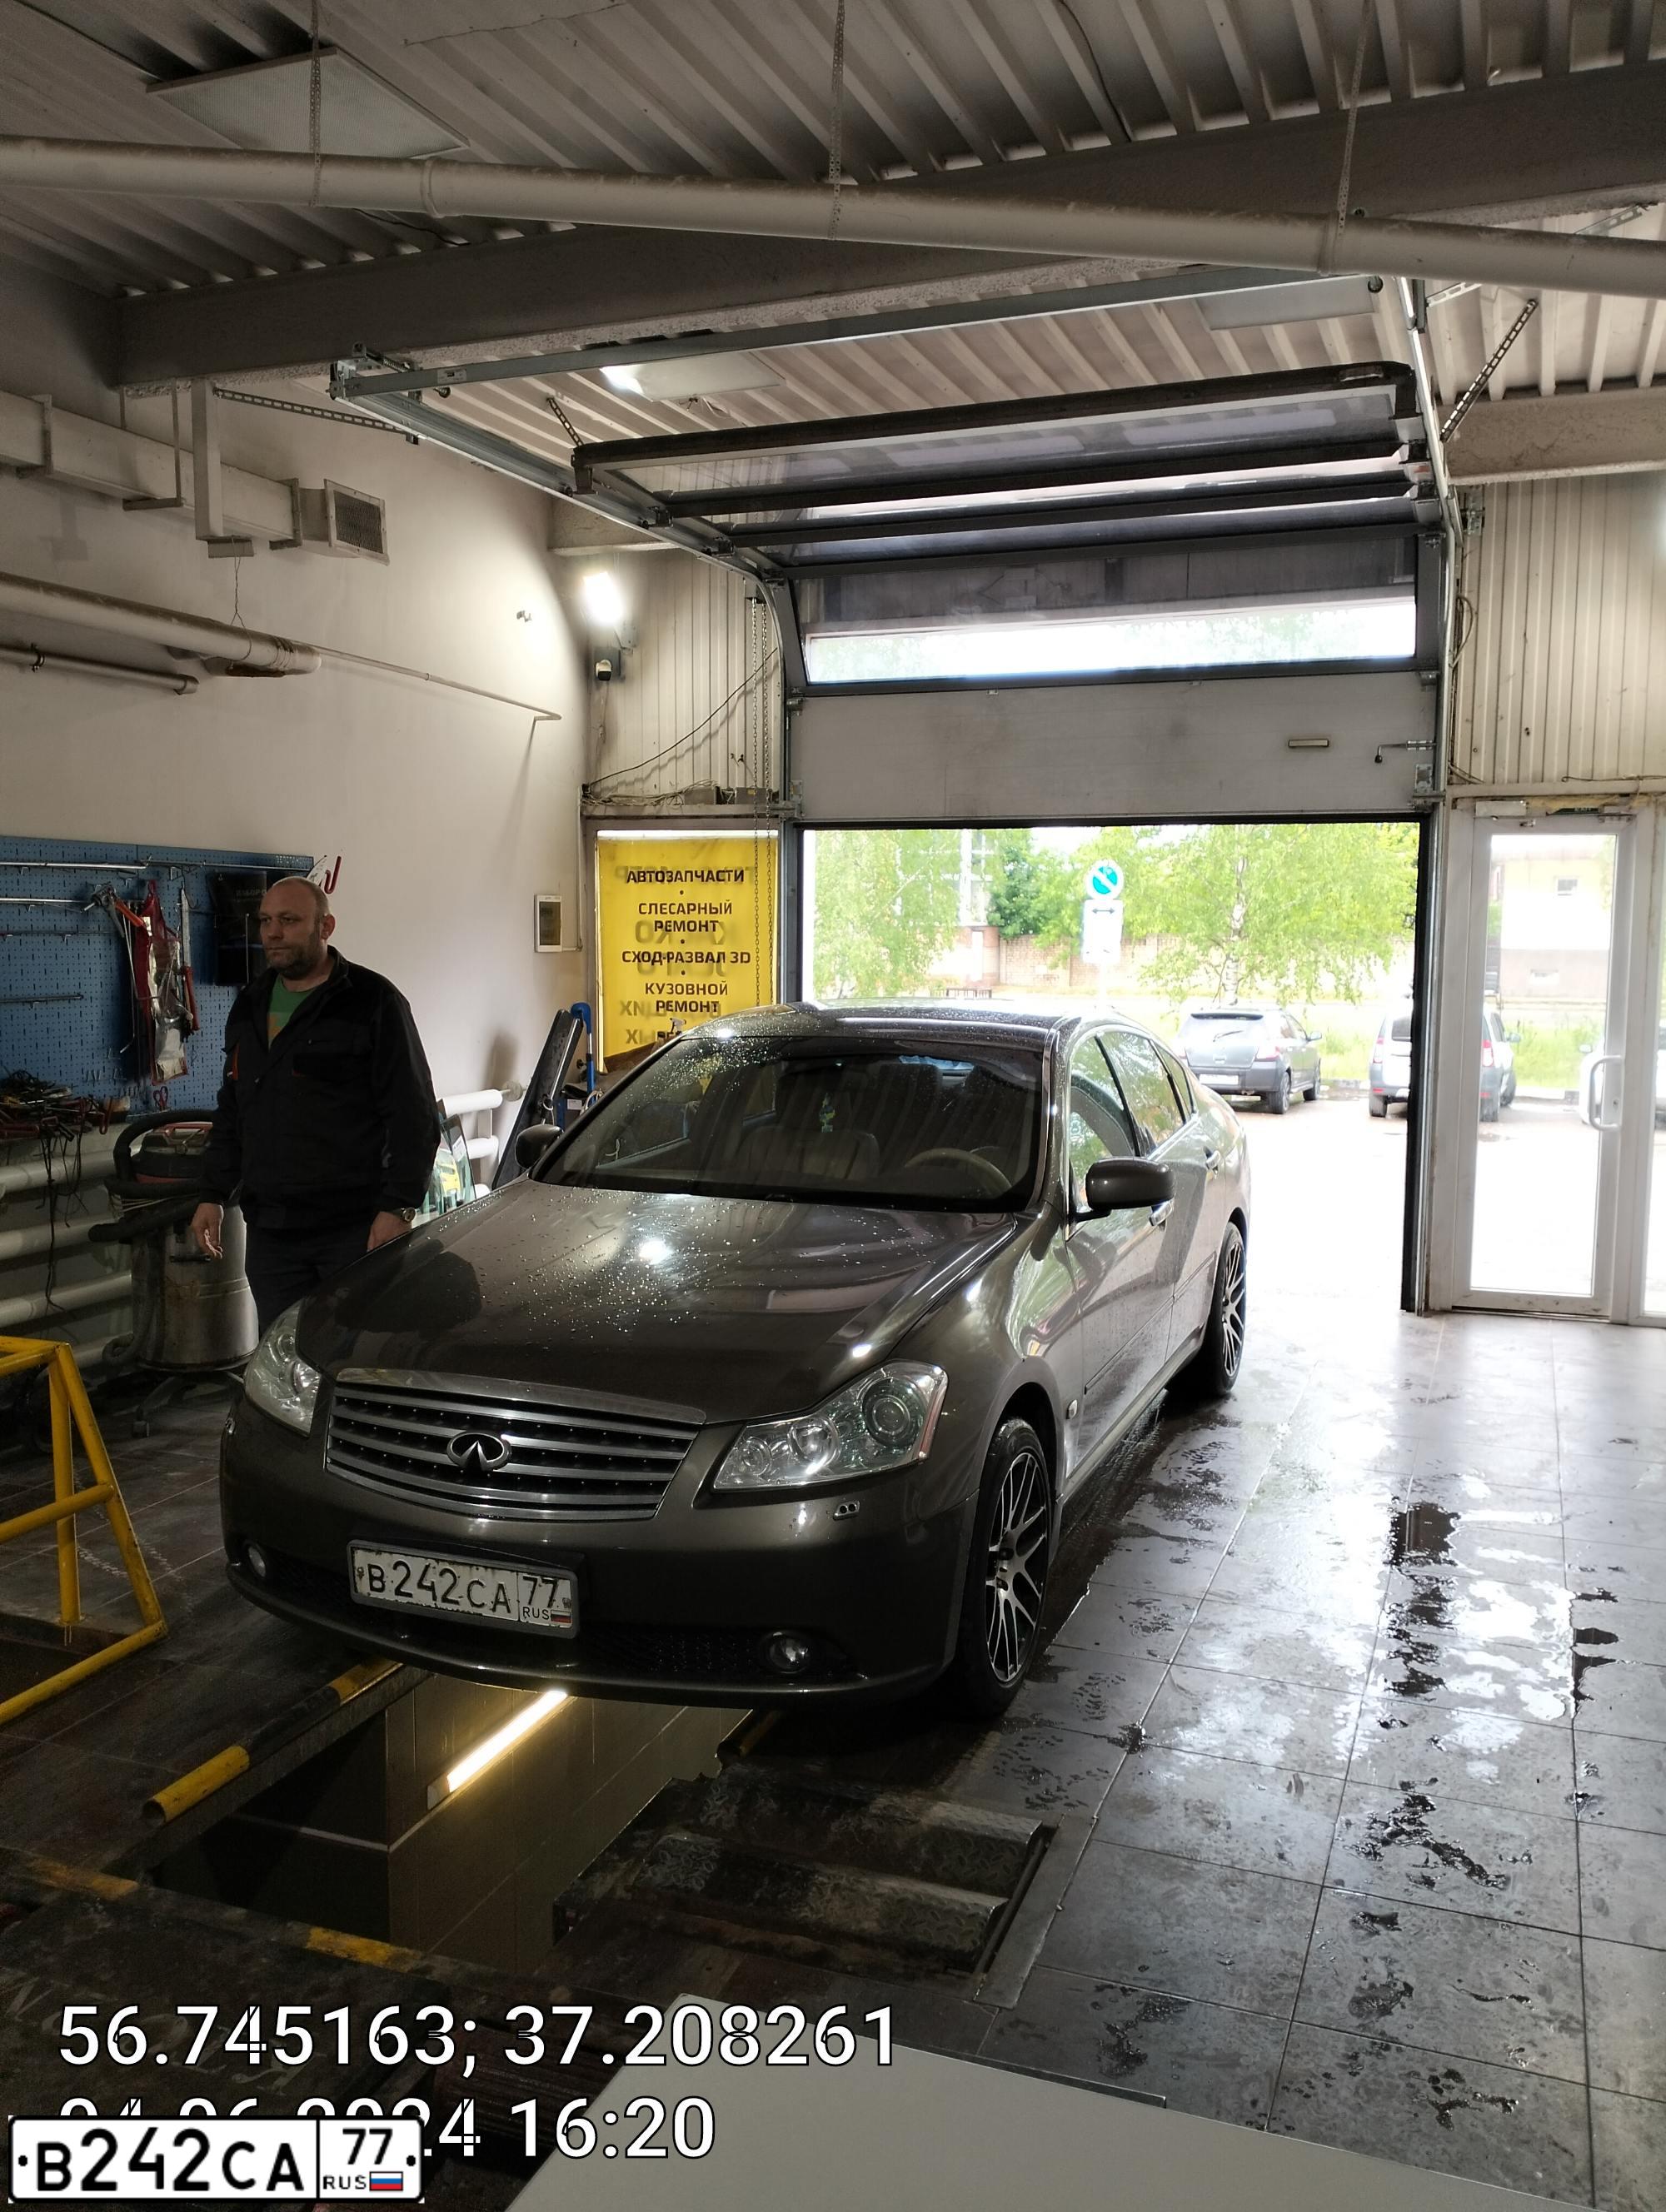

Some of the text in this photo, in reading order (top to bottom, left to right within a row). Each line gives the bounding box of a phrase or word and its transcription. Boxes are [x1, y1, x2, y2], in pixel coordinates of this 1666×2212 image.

[626, 869, 744, 883] АВТОЗАПЧАСТИ
[638, 899, 732, 914] СЛЕСАРНЫЙ
[654, 920, 719, 933] РЕМОНТ
[622, 950, 751, 965] СХОД-РАЗВАЛ 3D
[645, 980, 728, 996] КУЗОВНОЙ
[656, 1000, 720, 1013] РЕМОНТ
[522, 1607, 551, 1621] RUS
